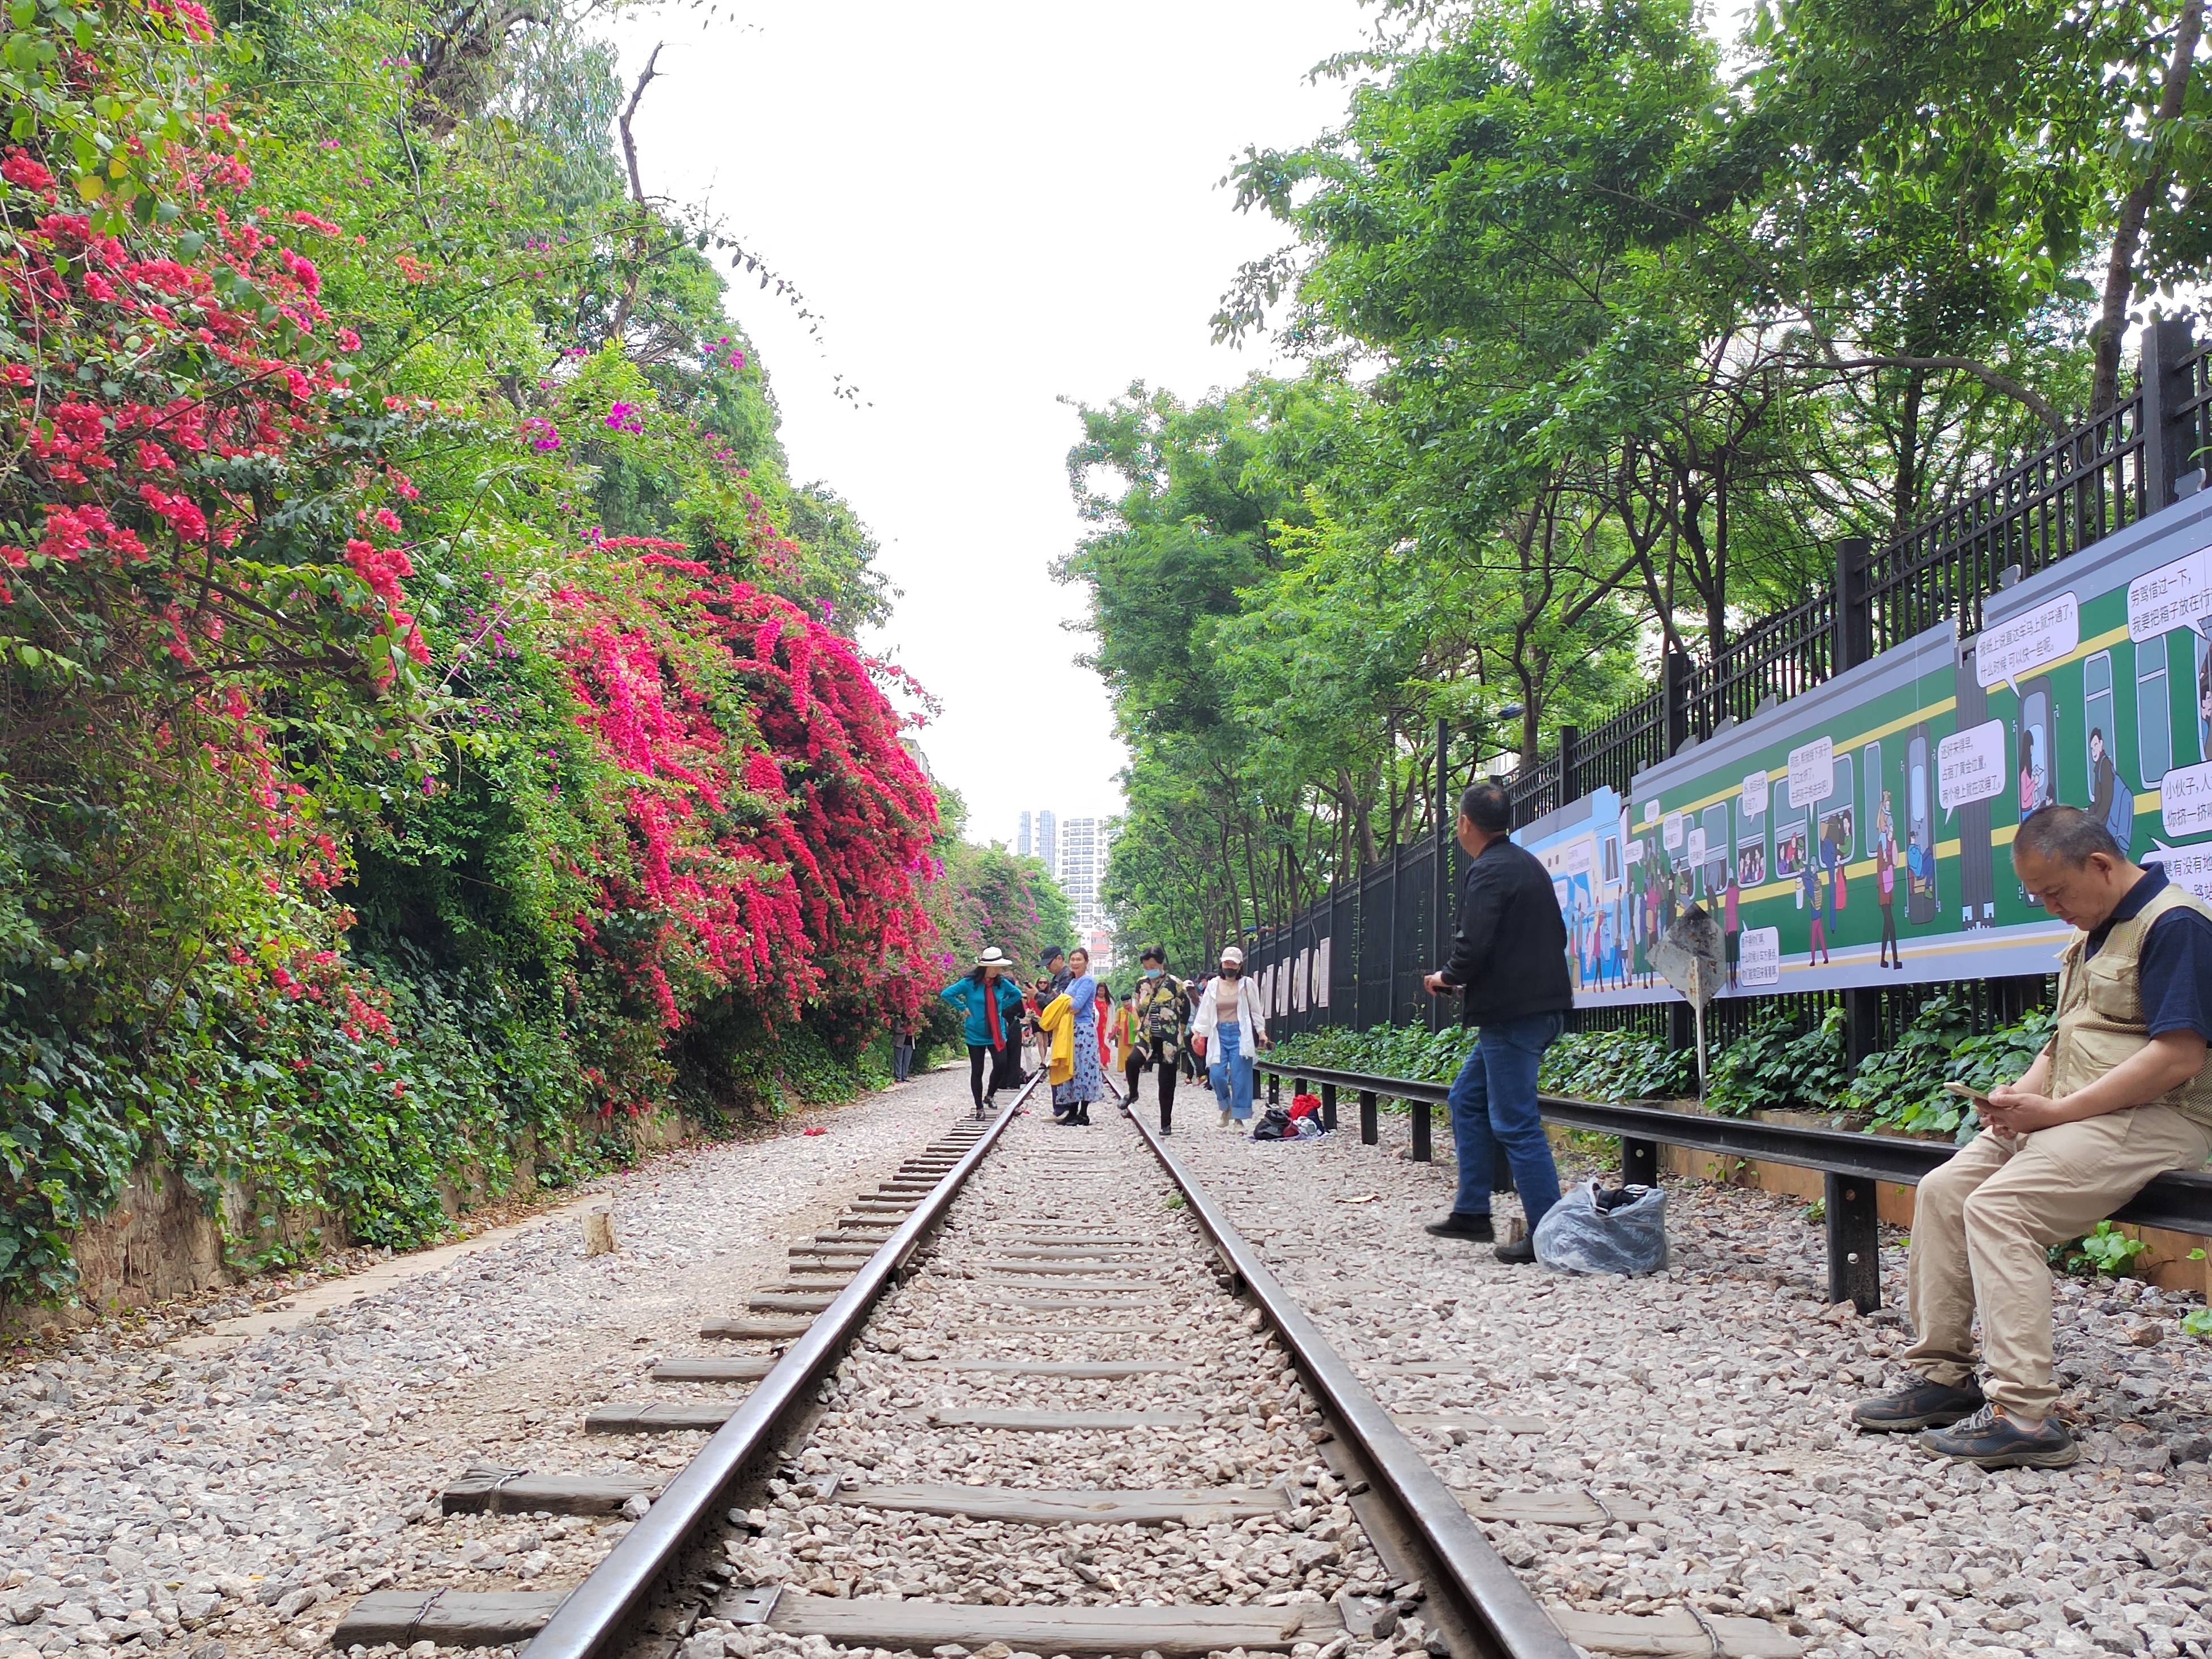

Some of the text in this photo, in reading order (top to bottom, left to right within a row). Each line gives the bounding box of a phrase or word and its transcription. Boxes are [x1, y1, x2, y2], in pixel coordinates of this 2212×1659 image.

[2132, 588, 2212, 635] 我要把箱子放在行
[2166, 773, 2212, 799] 小伙子，人
